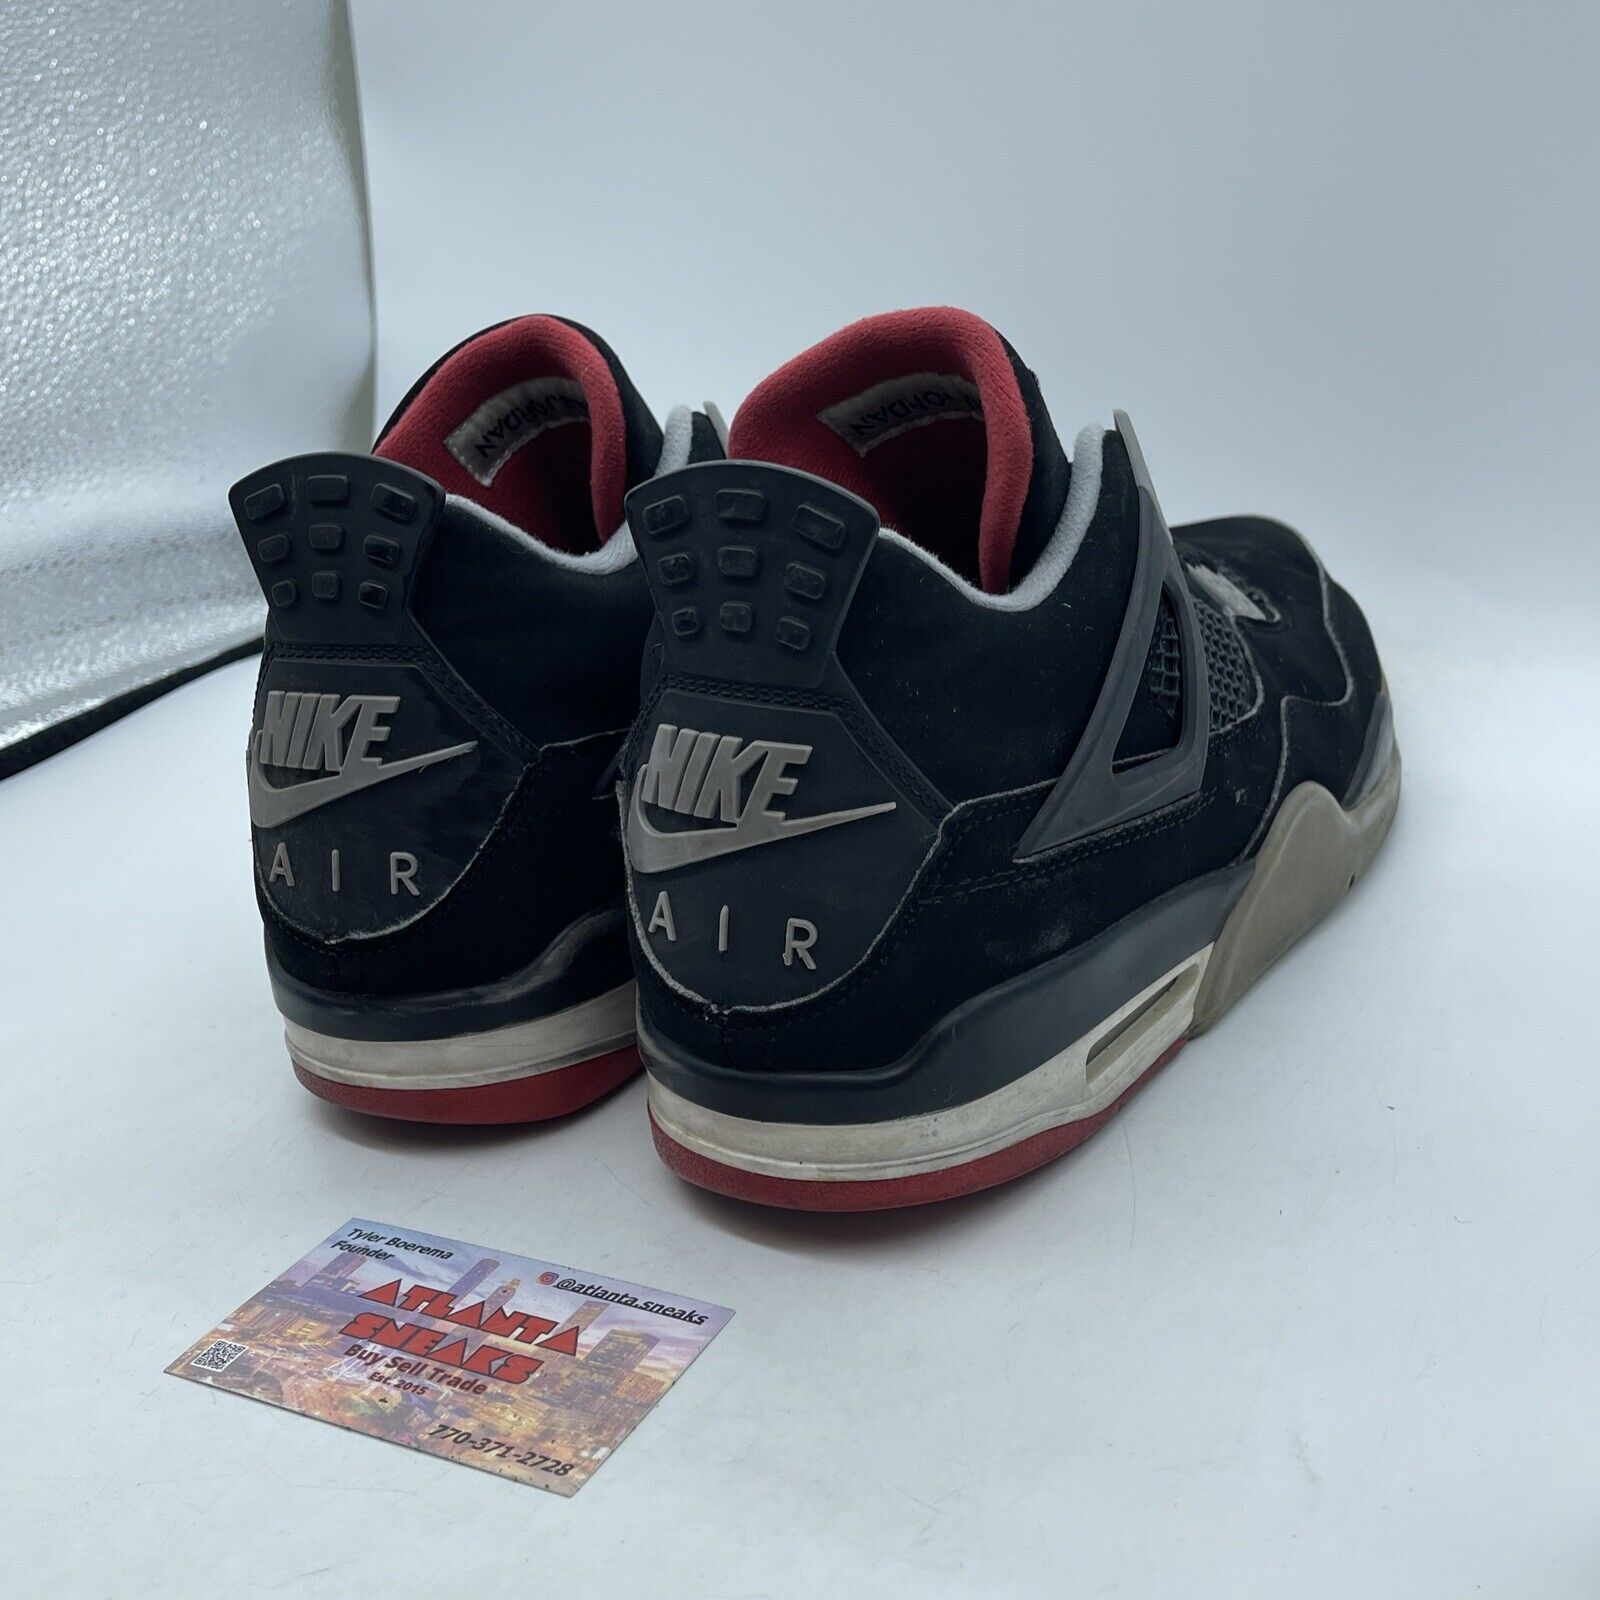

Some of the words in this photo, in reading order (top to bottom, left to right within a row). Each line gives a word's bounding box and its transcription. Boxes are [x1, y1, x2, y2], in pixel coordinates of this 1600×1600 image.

[259, 691, 401, 773] NIKE
[641, 723, 813, 823] NIKE
[270, 842, 421, 896] AIR
[648, 890, 818, 969] AIR
[331, 1240, 395, 1261] Founder
[347, 1228, 386, 1244] Tyler
[385, 1237, 453, 1260] Boerema
[357, 1278, 579, 1356] ATLANTA
[553, 1278, 709, 1325] @atlanta.sneaks
[339, 1312, 545, 1384] SNEAKS
[343, 1344, 386, 1366] Buy
[385, 1356, 425, 1380] Sell
[429, 1367, 487, 1395] Trade
[368, 1372, 395, 1386] Est.
[394, 1380, 428, 1396] 2015
[428, 1424, 575, 1476] 770-371-2728
